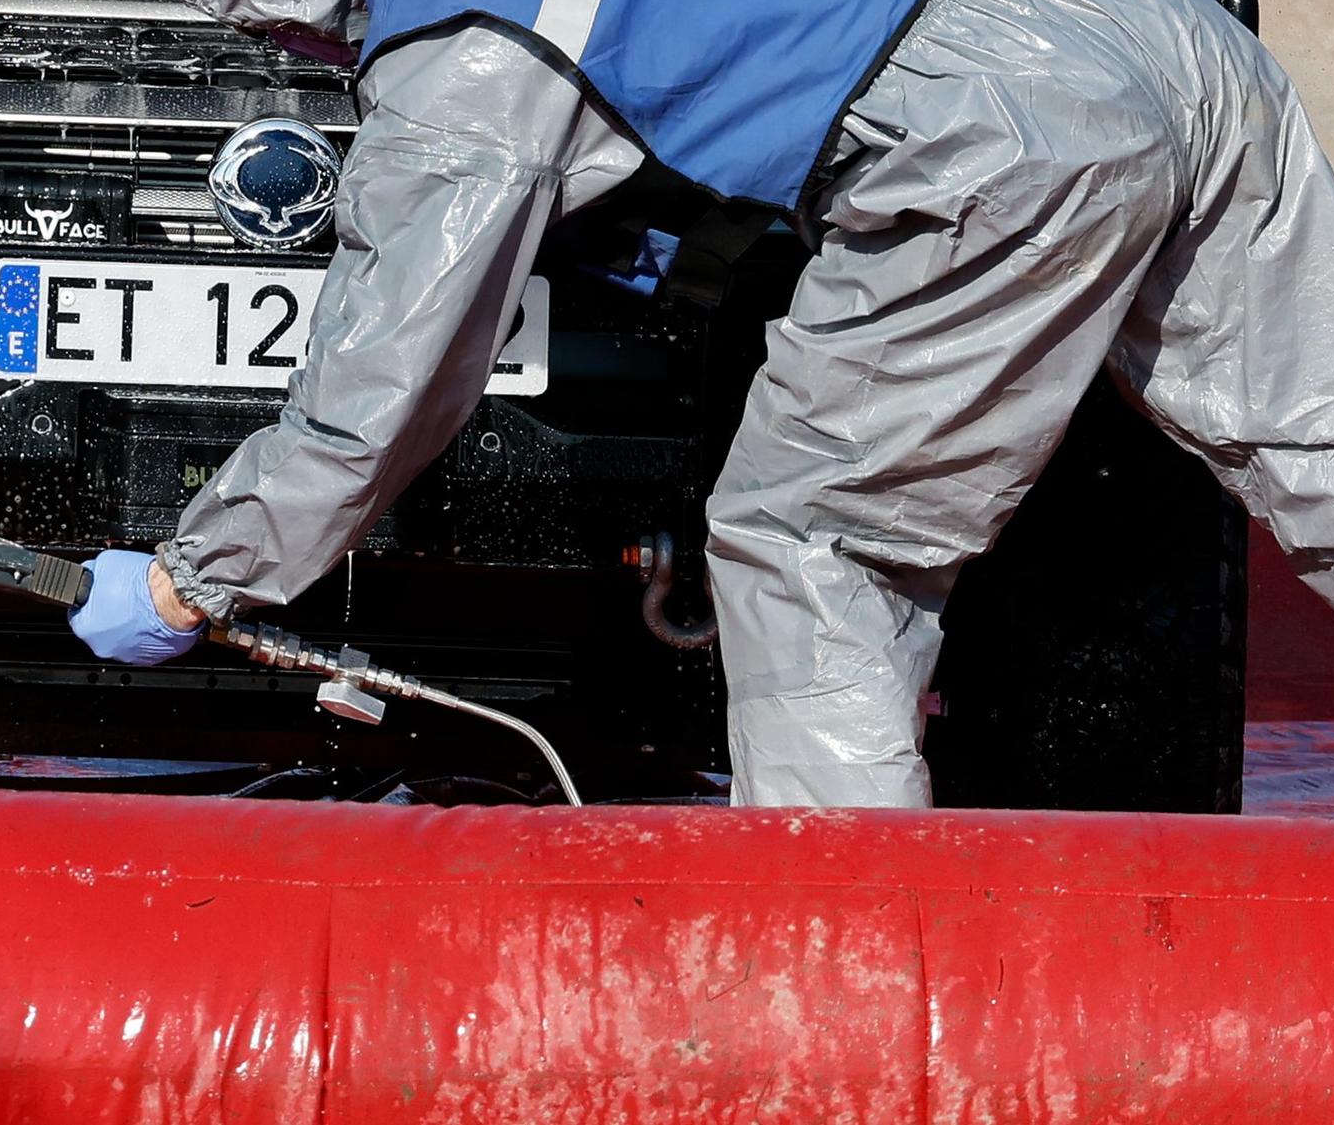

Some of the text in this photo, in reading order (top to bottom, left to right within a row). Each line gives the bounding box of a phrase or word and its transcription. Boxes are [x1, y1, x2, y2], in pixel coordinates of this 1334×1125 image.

[59, 221, 107, 240] FACE
[45, 276, 154, 363] ET
[8, 331, 25, 356] E
[184, 463, 218, 487] BU
